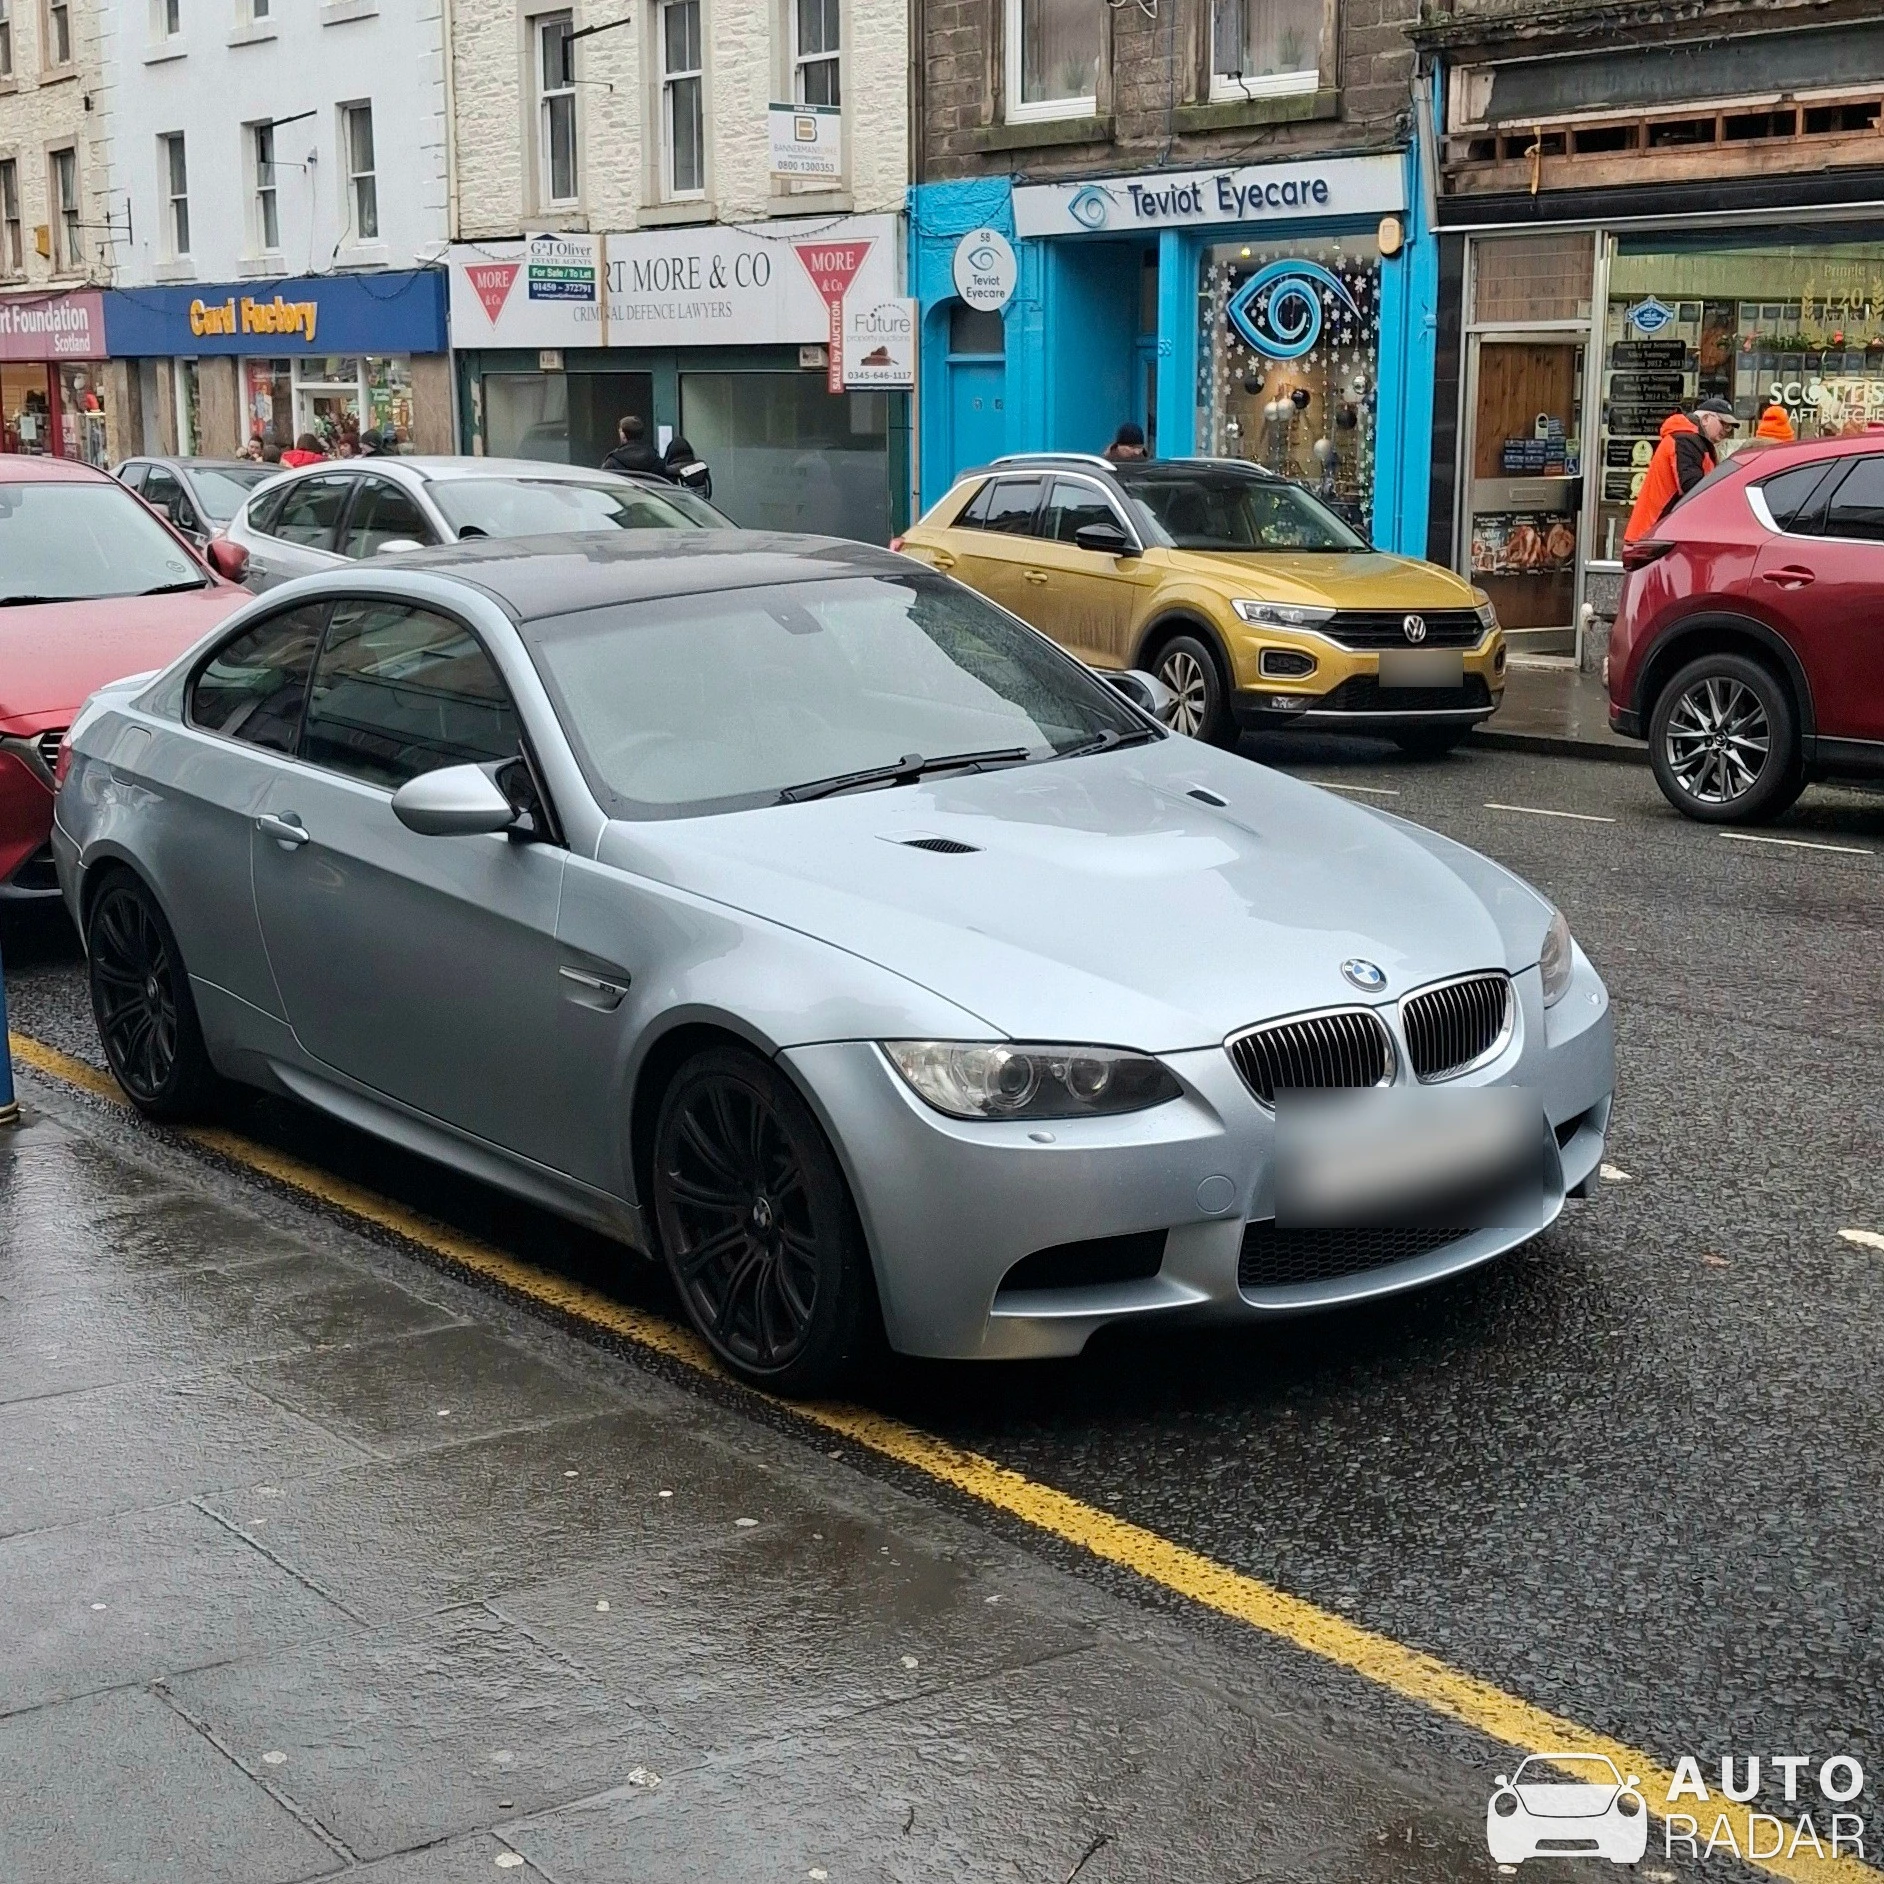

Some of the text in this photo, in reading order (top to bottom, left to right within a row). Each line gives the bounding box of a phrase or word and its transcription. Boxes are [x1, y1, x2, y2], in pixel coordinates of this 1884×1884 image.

[1127, 177, 1329, 219] Teviot Eyecare
[980, 232, 991, 243] 58
[556, 243, 592, 256] Oliver
[633, 256, 701, 292] MORE
[709, 254, 728, 289] &
[735, 251, 771, 288] CO
[810, 252, 856, 272] MORE
[476, 270, 510, 289] MORE
[532, 268, 546, 277] For
[547, 268, 563, 278] Sale
[569, 269, 579, 278] To
[580, 270, 592, 279] Let
[972, 274, 1000, 286] Teviot
[532, 283, 557, 292] 01450
[821, 279, 830, 292] &
[966, 287, 1005, 300] Eyecare
[485, 295, 491, 306] &
[1826, 287, 1865, 310] 120
[13, 300, 89, 333] Foundation
[190, 296, 318, 341] Card Factory
[627, 303, 675, 320] DEFENCE
[678, 301, 733, 319] LAWYERS
[855, 314, 911, 333] Future
[54, 333, 91, 352] Scotland
[832, 300, 843, 391] SALE by AUCTION
